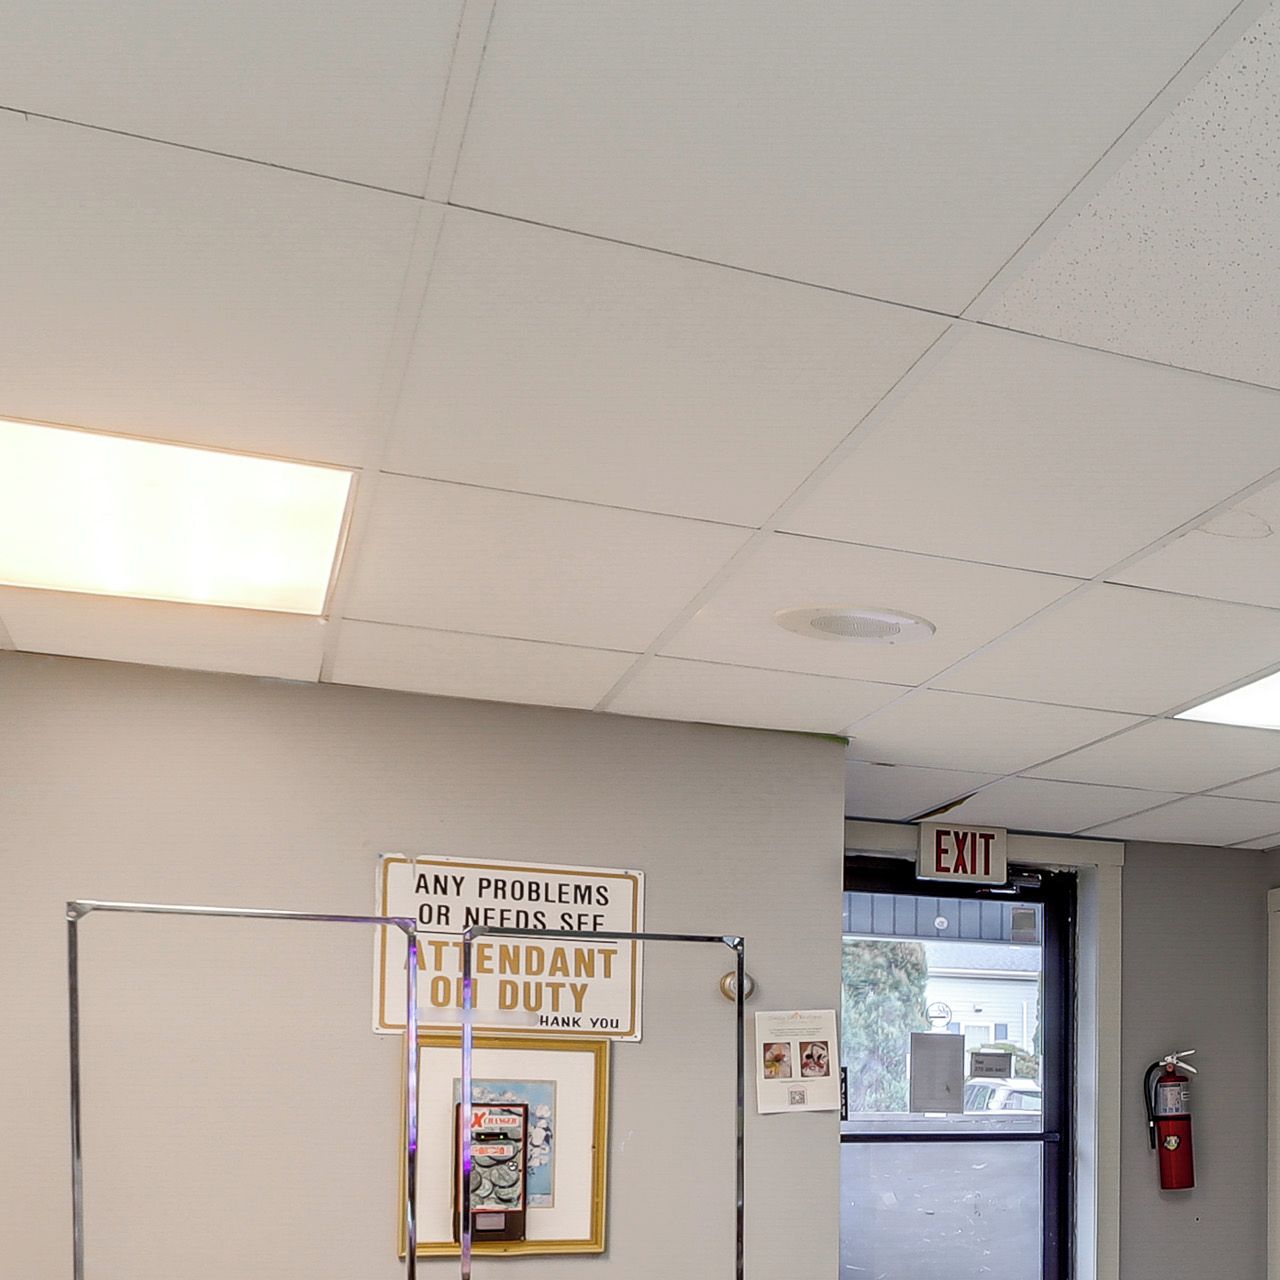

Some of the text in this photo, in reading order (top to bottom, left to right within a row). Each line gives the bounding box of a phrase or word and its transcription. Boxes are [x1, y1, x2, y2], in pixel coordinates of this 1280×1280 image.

[935, 829, 995, 876] EXIT
[415, 873, 610, 906] ANY PROBLEMS
[418, 903, 605, 932] OR NEEDS SEE
[499, 979, 589, 1014] DUTY
[539, 1014, 620, 1029] HANK YOU
